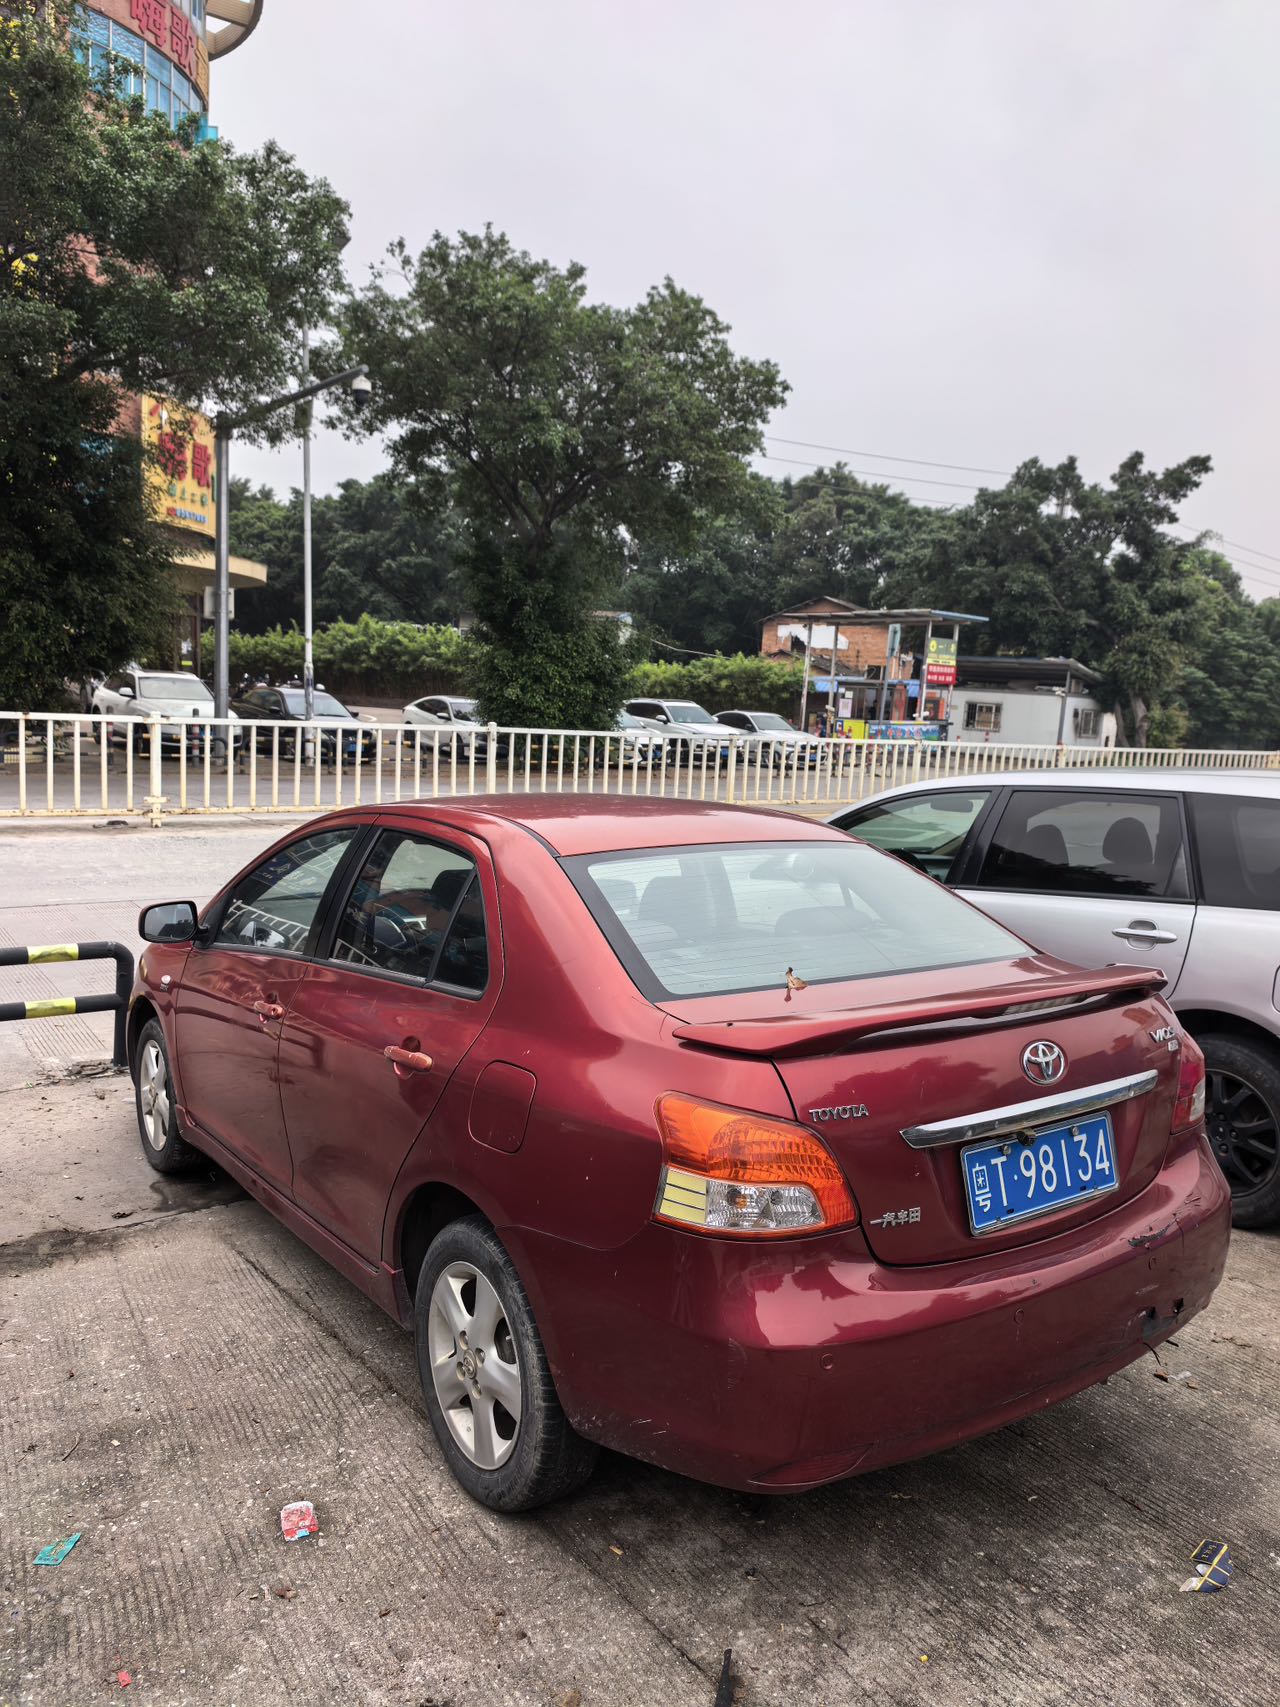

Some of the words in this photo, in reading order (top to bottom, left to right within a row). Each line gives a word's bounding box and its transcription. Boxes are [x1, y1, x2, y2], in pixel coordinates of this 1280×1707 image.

[1149, 1026, 1176, 1043] VIOS
[808, 1103, 869, 1122] TOYOTA
[971, 1128, 1111, 1213] 粤T·98134
